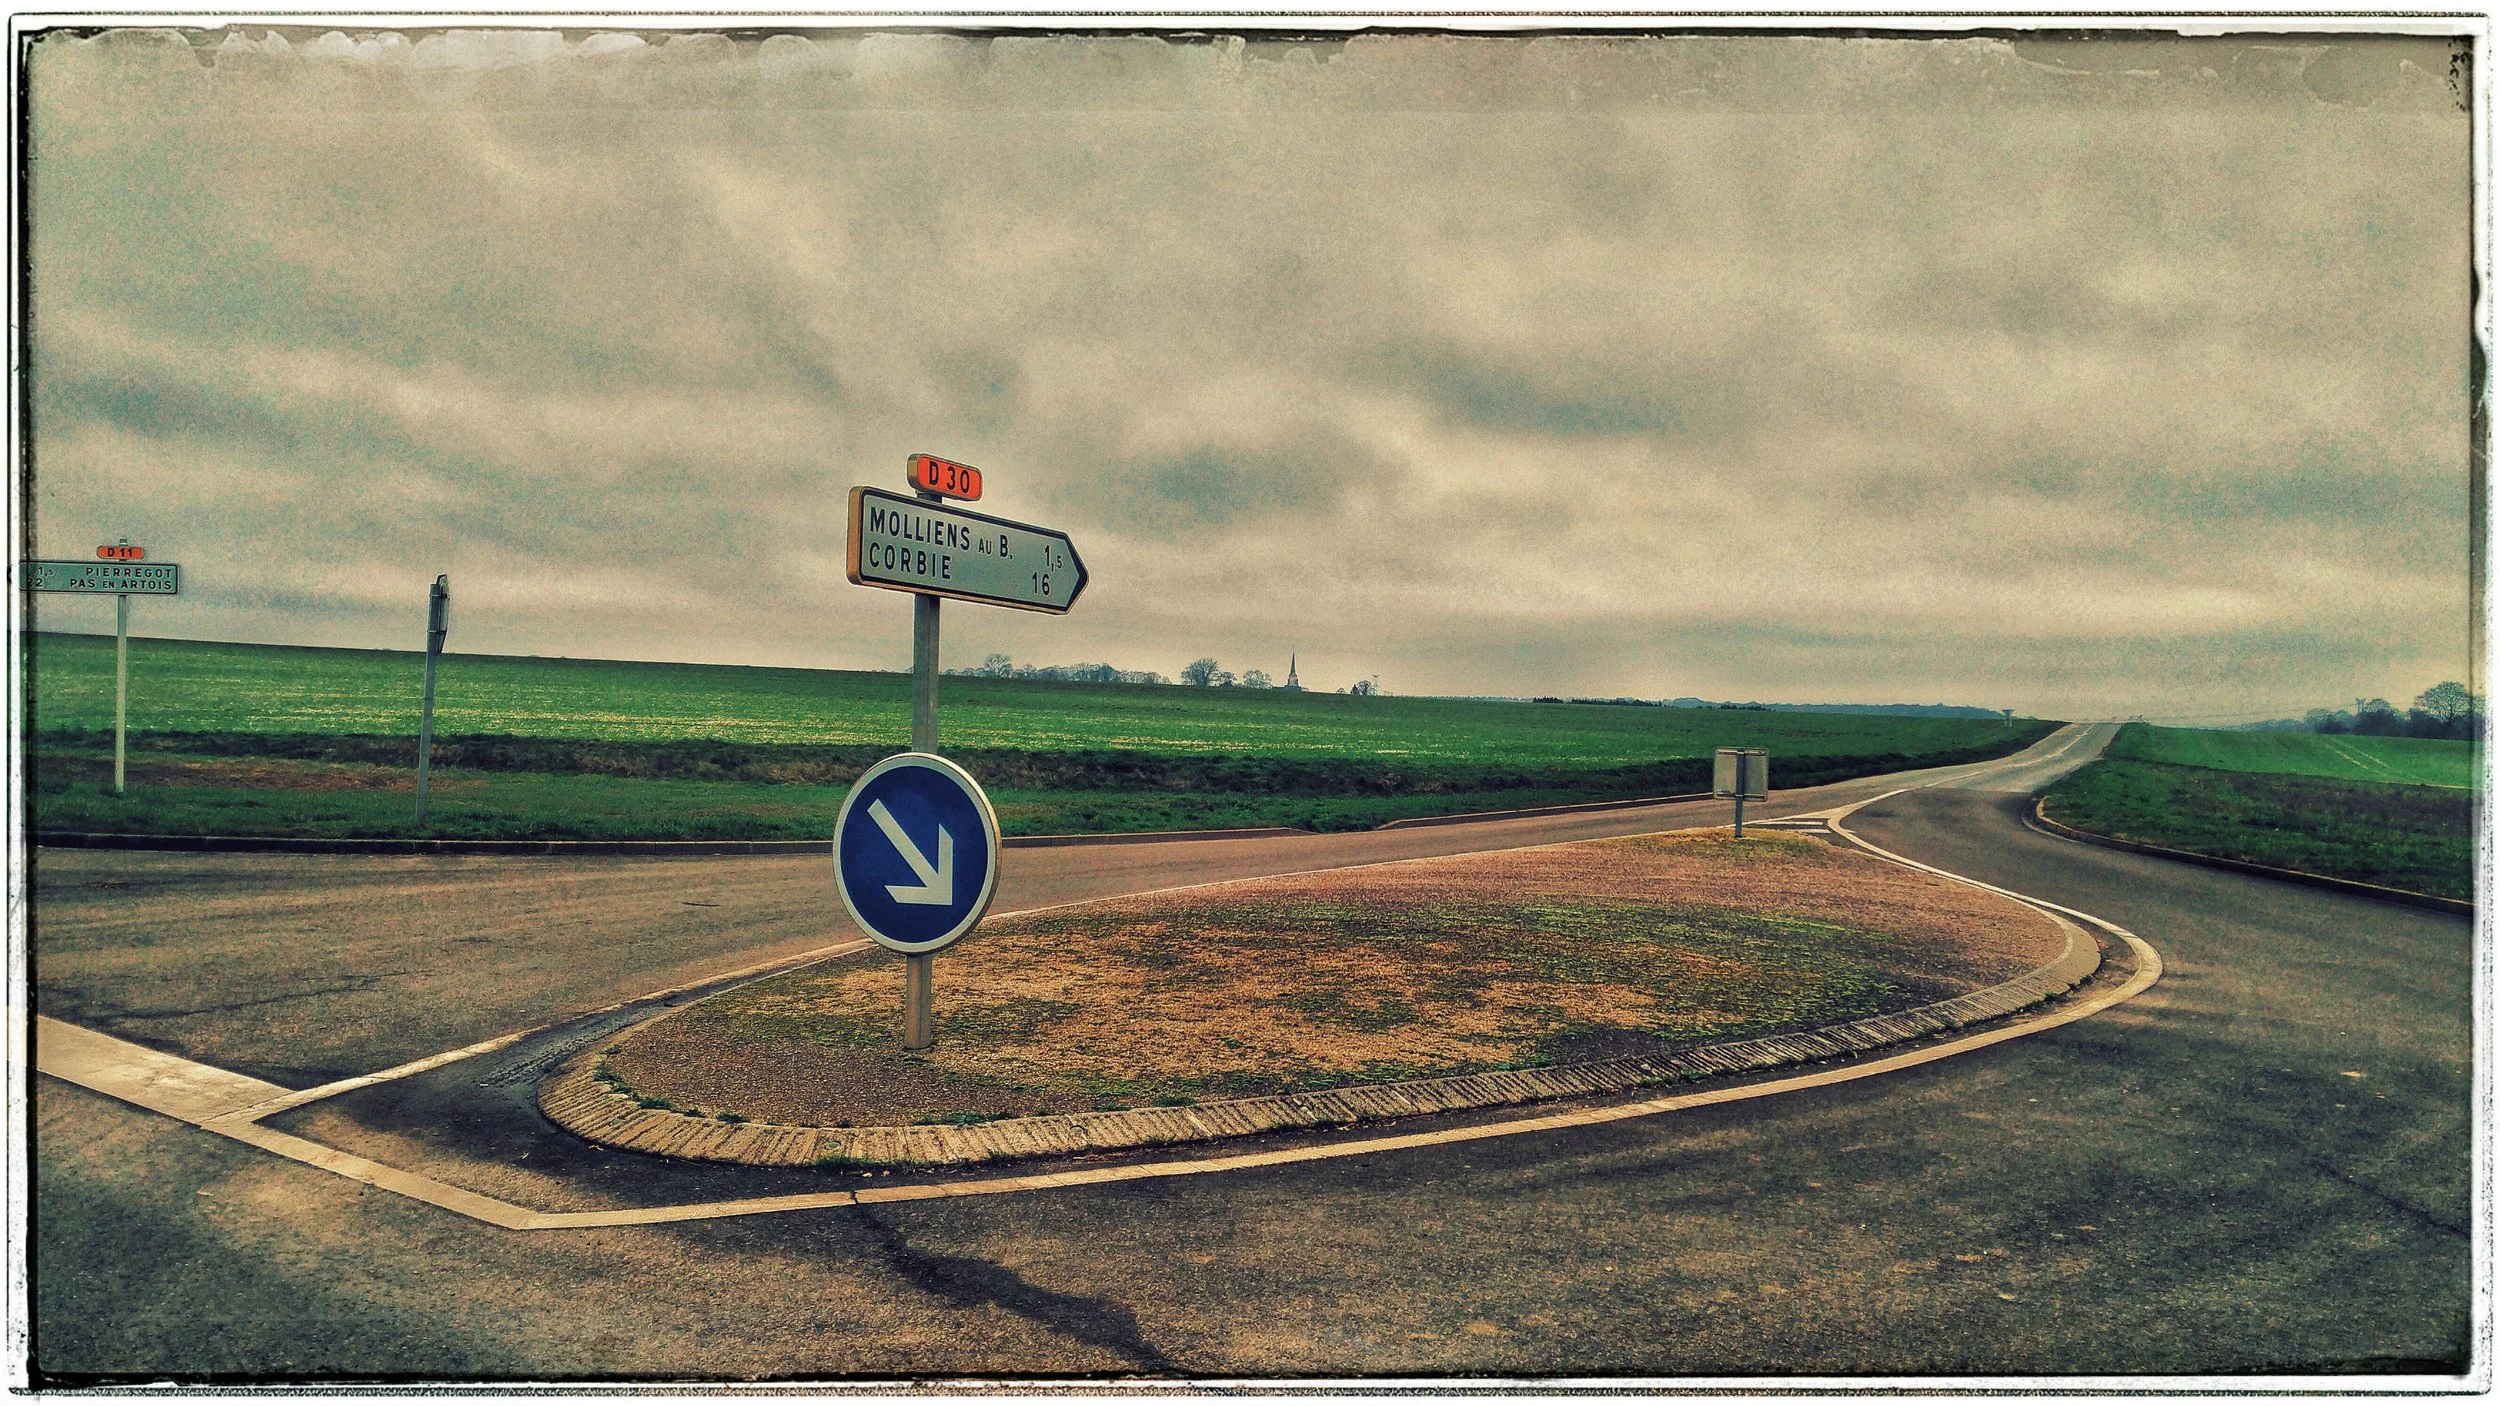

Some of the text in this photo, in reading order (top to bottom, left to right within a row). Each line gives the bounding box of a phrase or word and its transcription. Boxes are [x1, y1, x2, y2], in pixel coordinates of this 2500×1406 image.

[929, 461, 970, 494] D 30
[870, 506, 1063, 572] MOLLIENS AU B. 1,5
[107, 548, 133, 557] D 11
[86, 567, 172, 578] PIERREGOT
[869, 541, 1051, 596] CORBIE 16
[70, 579, 96, 588] PAS
[121, 580, 172, 590] ARTOIS
